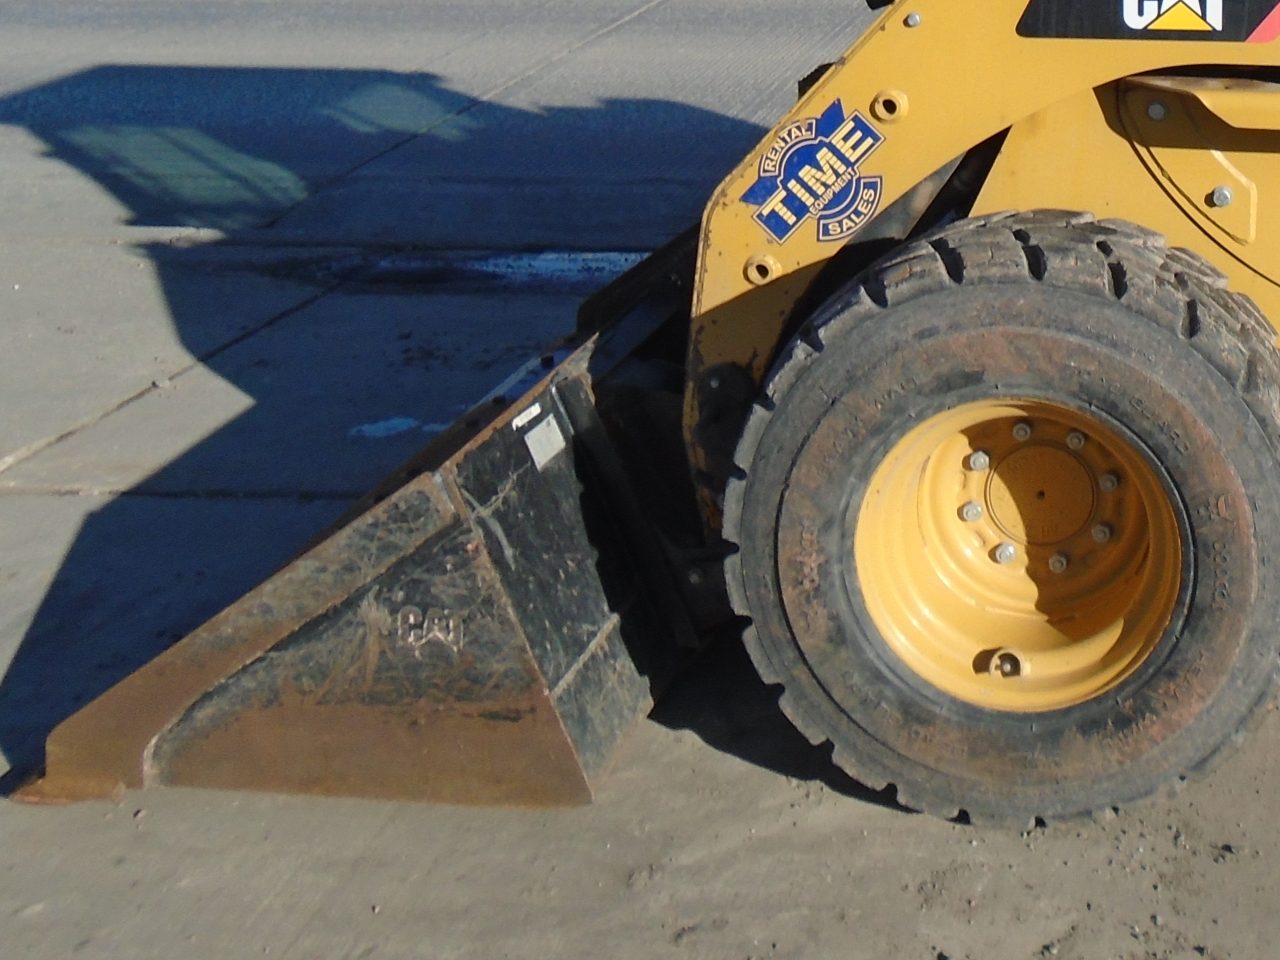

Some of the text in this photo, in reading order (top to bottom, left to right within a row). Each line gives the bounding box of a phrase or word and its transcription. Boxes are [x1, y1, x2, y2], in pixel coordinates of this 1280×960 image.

[764, 124, 812, 172] RENTAL
[762, 120, 875, 225] TIME
[810, 167, 856, 215] EQUIPMENT
[828, 188, 876, 235] SALES
[397, 604, 465, 653] CAT
